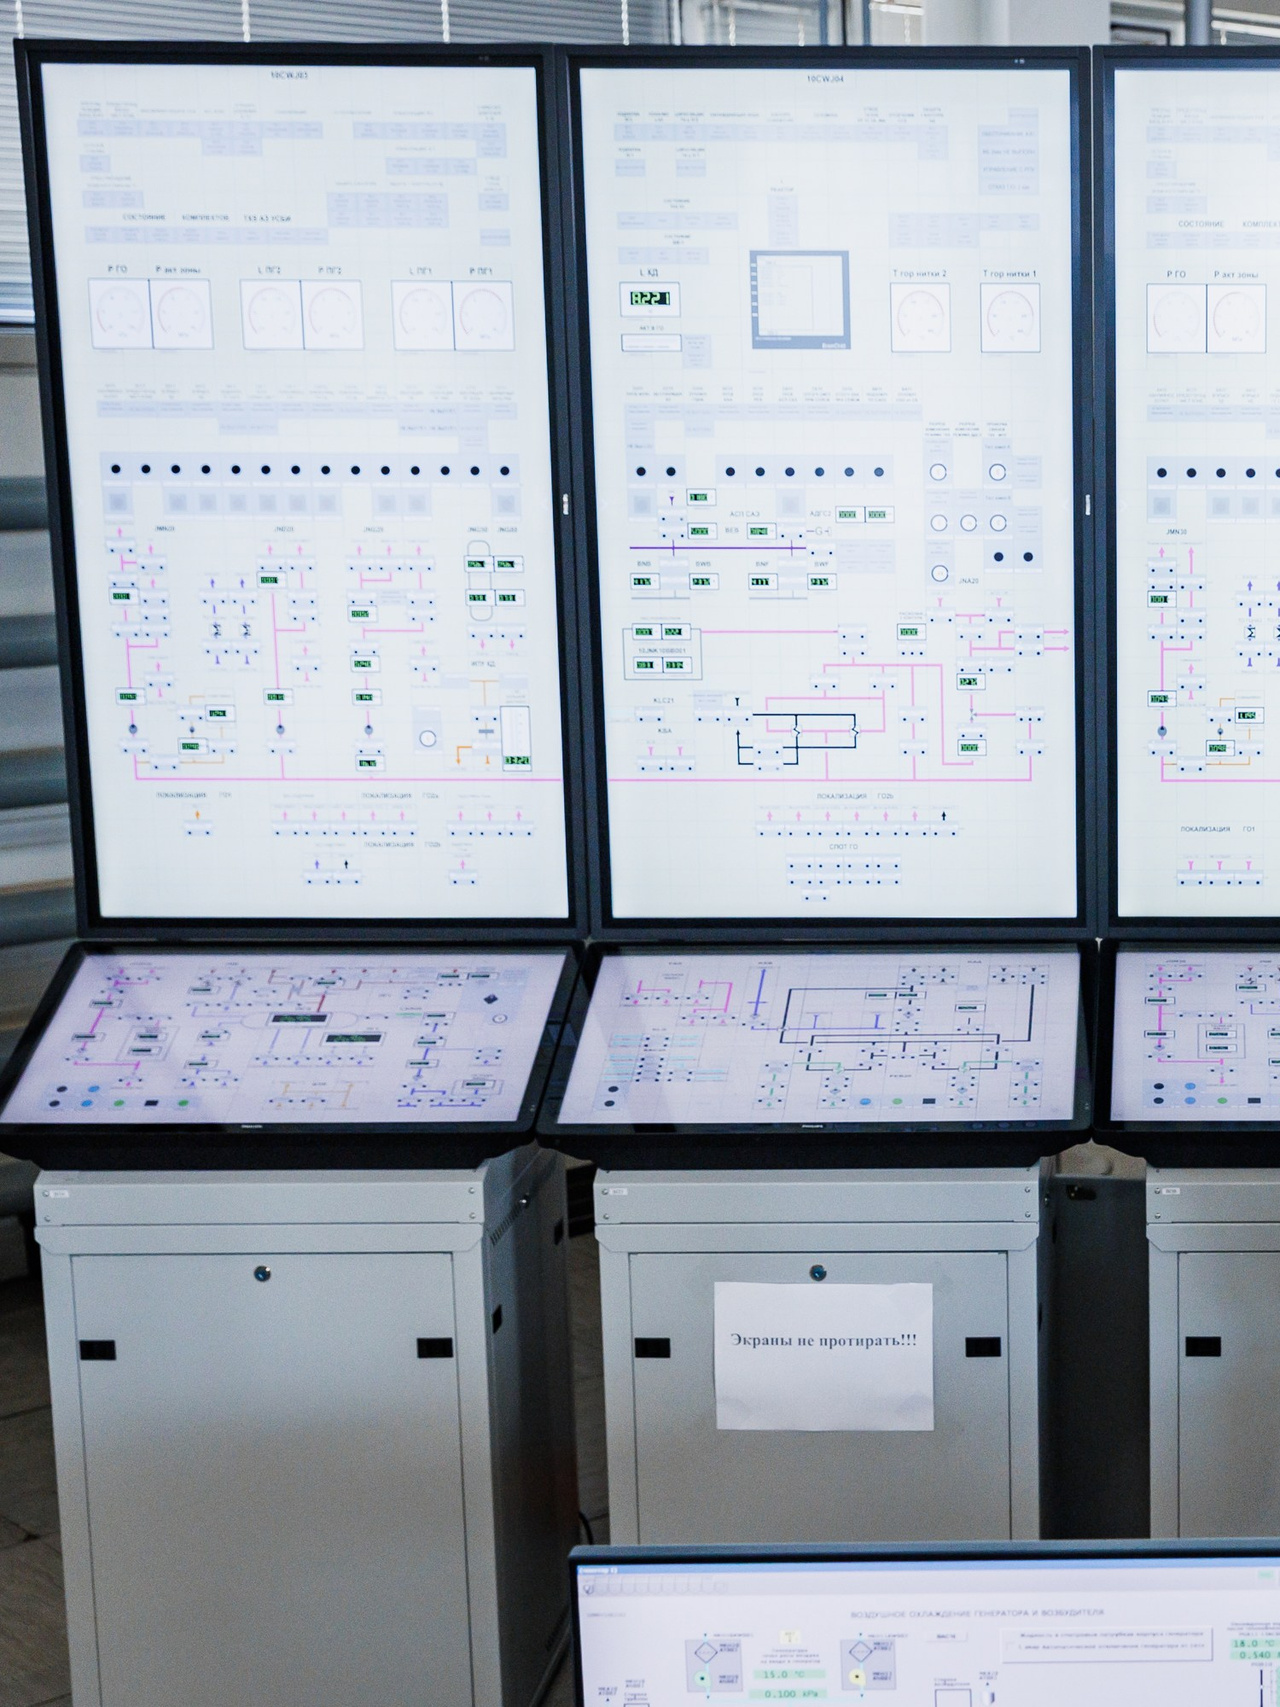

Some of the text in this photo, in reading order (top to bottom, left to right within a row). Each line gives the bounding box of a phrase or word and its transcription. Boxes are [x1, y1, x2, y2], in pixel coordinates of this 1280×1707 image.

[942, 270, 947, 278] 2
[631, 292, 670, 305] 8221
[731, 1333, 917, 1349] Экраны не протирать!!!
[1042, 1609, 1104, 1617] ВОЗБУДИТЕЛЯ
[764, 1671, 788, 1679] 15.0
[765, 1690, 795, 1698] 0.100
